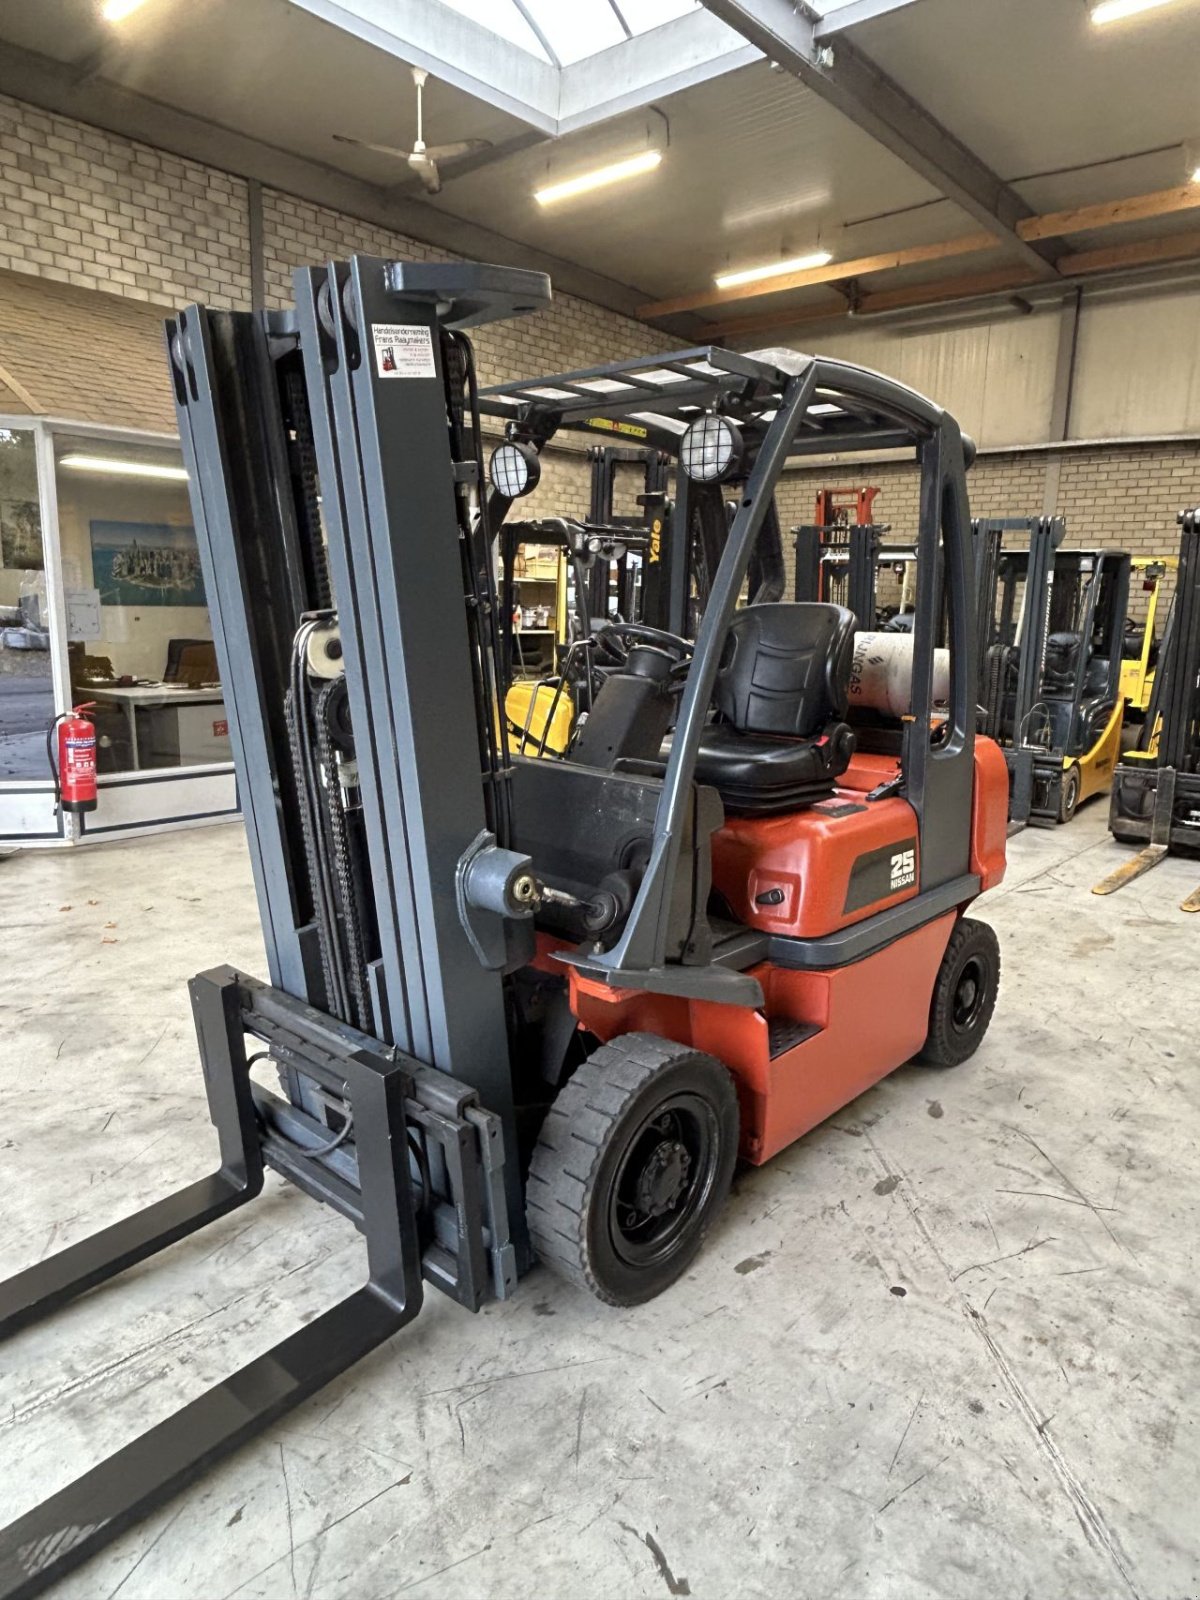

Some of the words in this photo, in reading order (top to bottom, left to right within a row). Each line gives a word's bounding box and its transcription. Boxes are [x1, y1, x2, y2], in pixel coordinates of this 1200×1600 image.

[375, 335, 393, 343] Frans
[849, 634, 876, 696] RIJNGAS
[890, 849, 914, 879] 25
[890, 872, 914, 889] NISSAN
